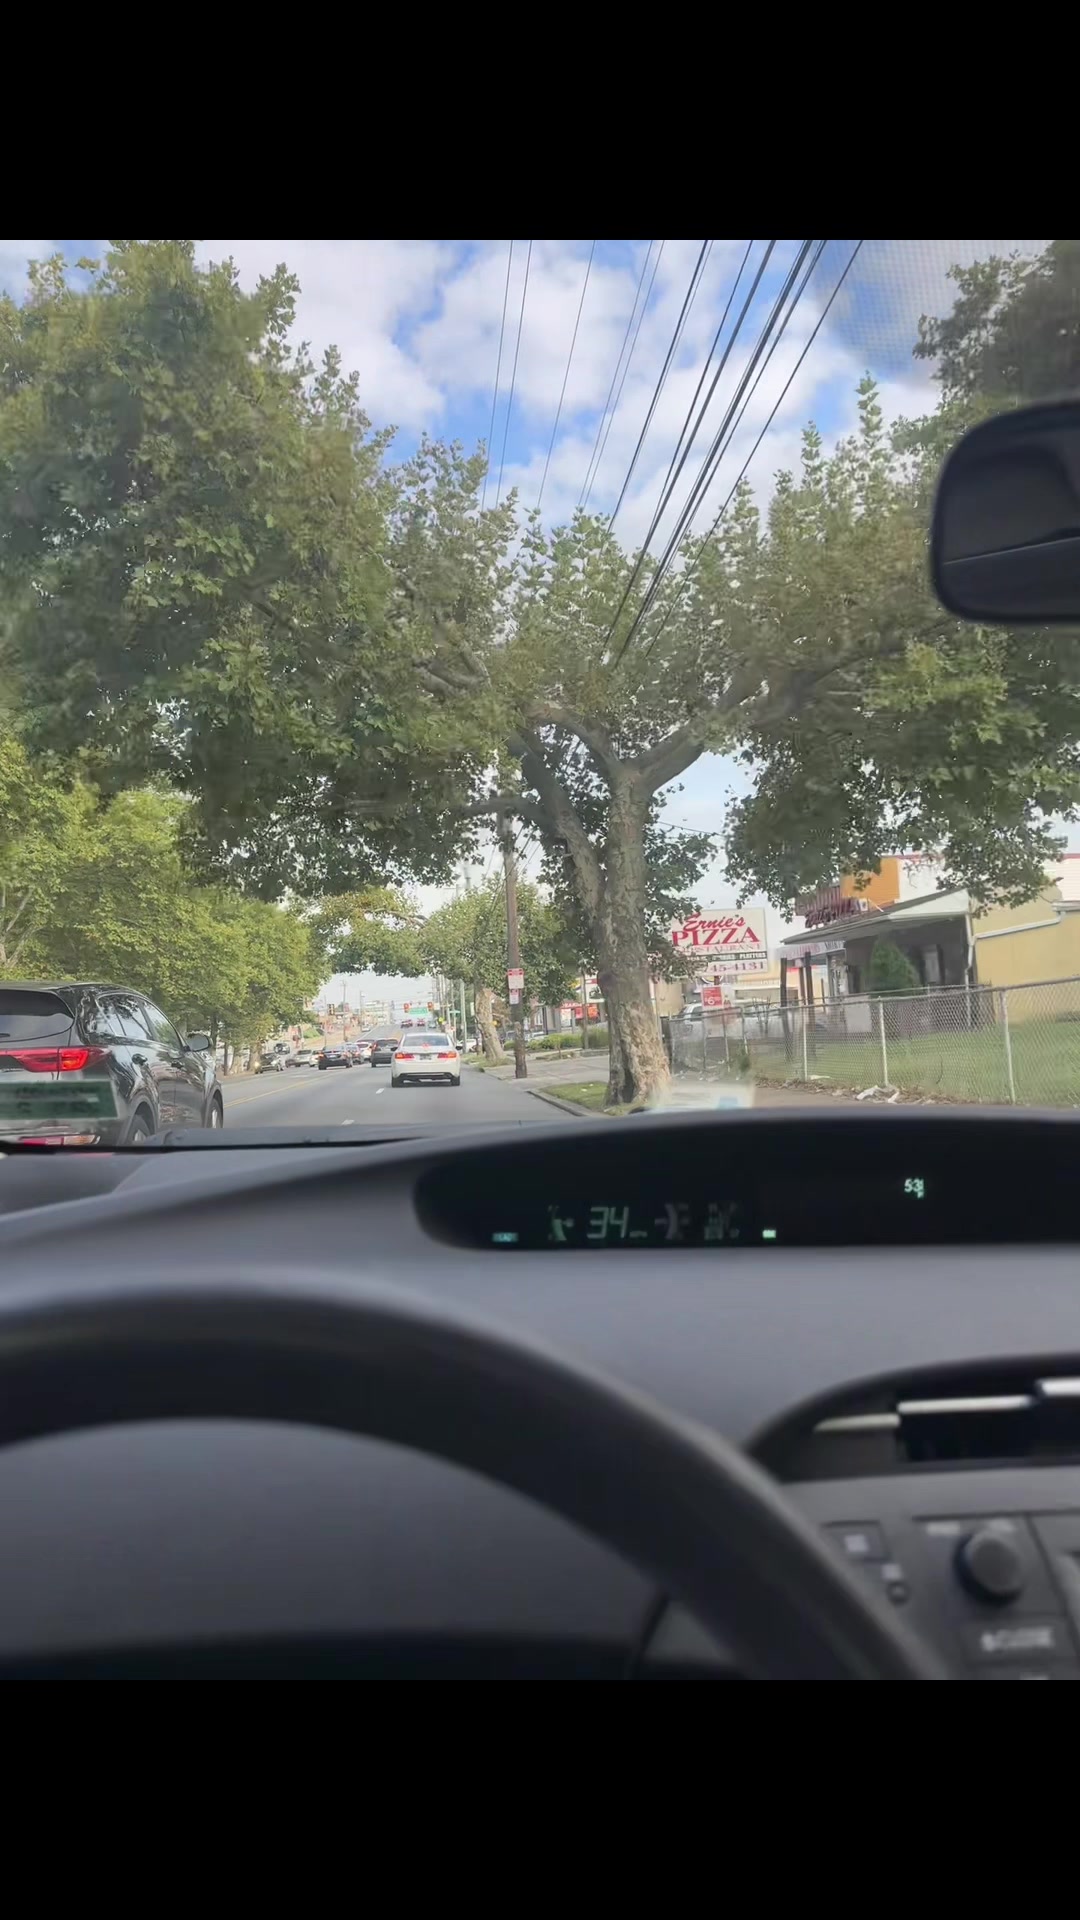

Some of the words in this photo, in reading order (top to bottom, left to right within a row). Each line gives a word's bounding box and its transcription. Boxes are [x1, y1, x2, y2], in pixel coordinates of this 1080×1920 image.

[683, 911, 746, 931] Ernie's
[672, 926, 760, 946] PIZZA
[679, 942, 761, 955] STAURANT
[587, 1206, 630, 1239] 34
